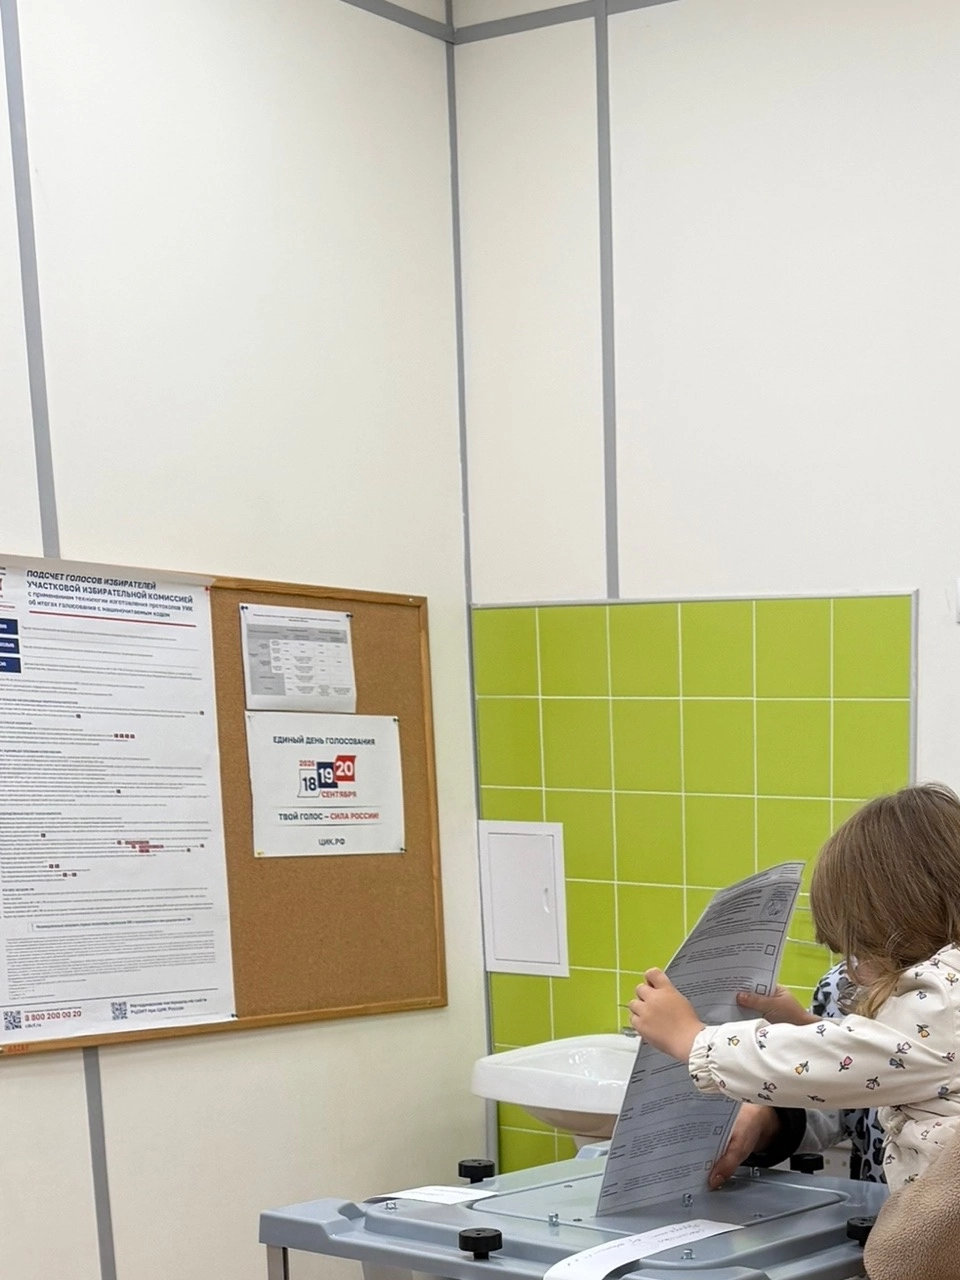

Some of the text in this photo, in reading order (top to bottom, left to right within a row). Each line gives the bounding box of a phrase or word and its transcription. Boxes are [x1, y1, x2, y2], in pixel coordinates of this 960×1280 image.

[26, 569, 156, 590] ПОДСЧЕТ ГОЛОСОВ ИЗБИРАТЕЛЕЙ
[26, 580, 193, 604] УЧАСТКОВОЙ ИЗБИРАТЕЛЬНОЙ КОМИССИЕЙ
[273, 735, 375, 745] ЕДИНЫЙ ДЕНЬ ГОЛОСОВАНИЯ
[318, 767, 333, 783] 19
[335, 760, 353, 776] 20
[302, 776, 317, 791] 18
[321, 790, 356, 798] СЕНТЯБРЯ
[278, 811, 298, 821] ТВОЙ
[300, 812, 323, 820] ГОЛОС
[330, 812, 349, 820] СИЛА
[31, 1013, 45, 1021] 800
[47, 1012, 60, 1020] 200
